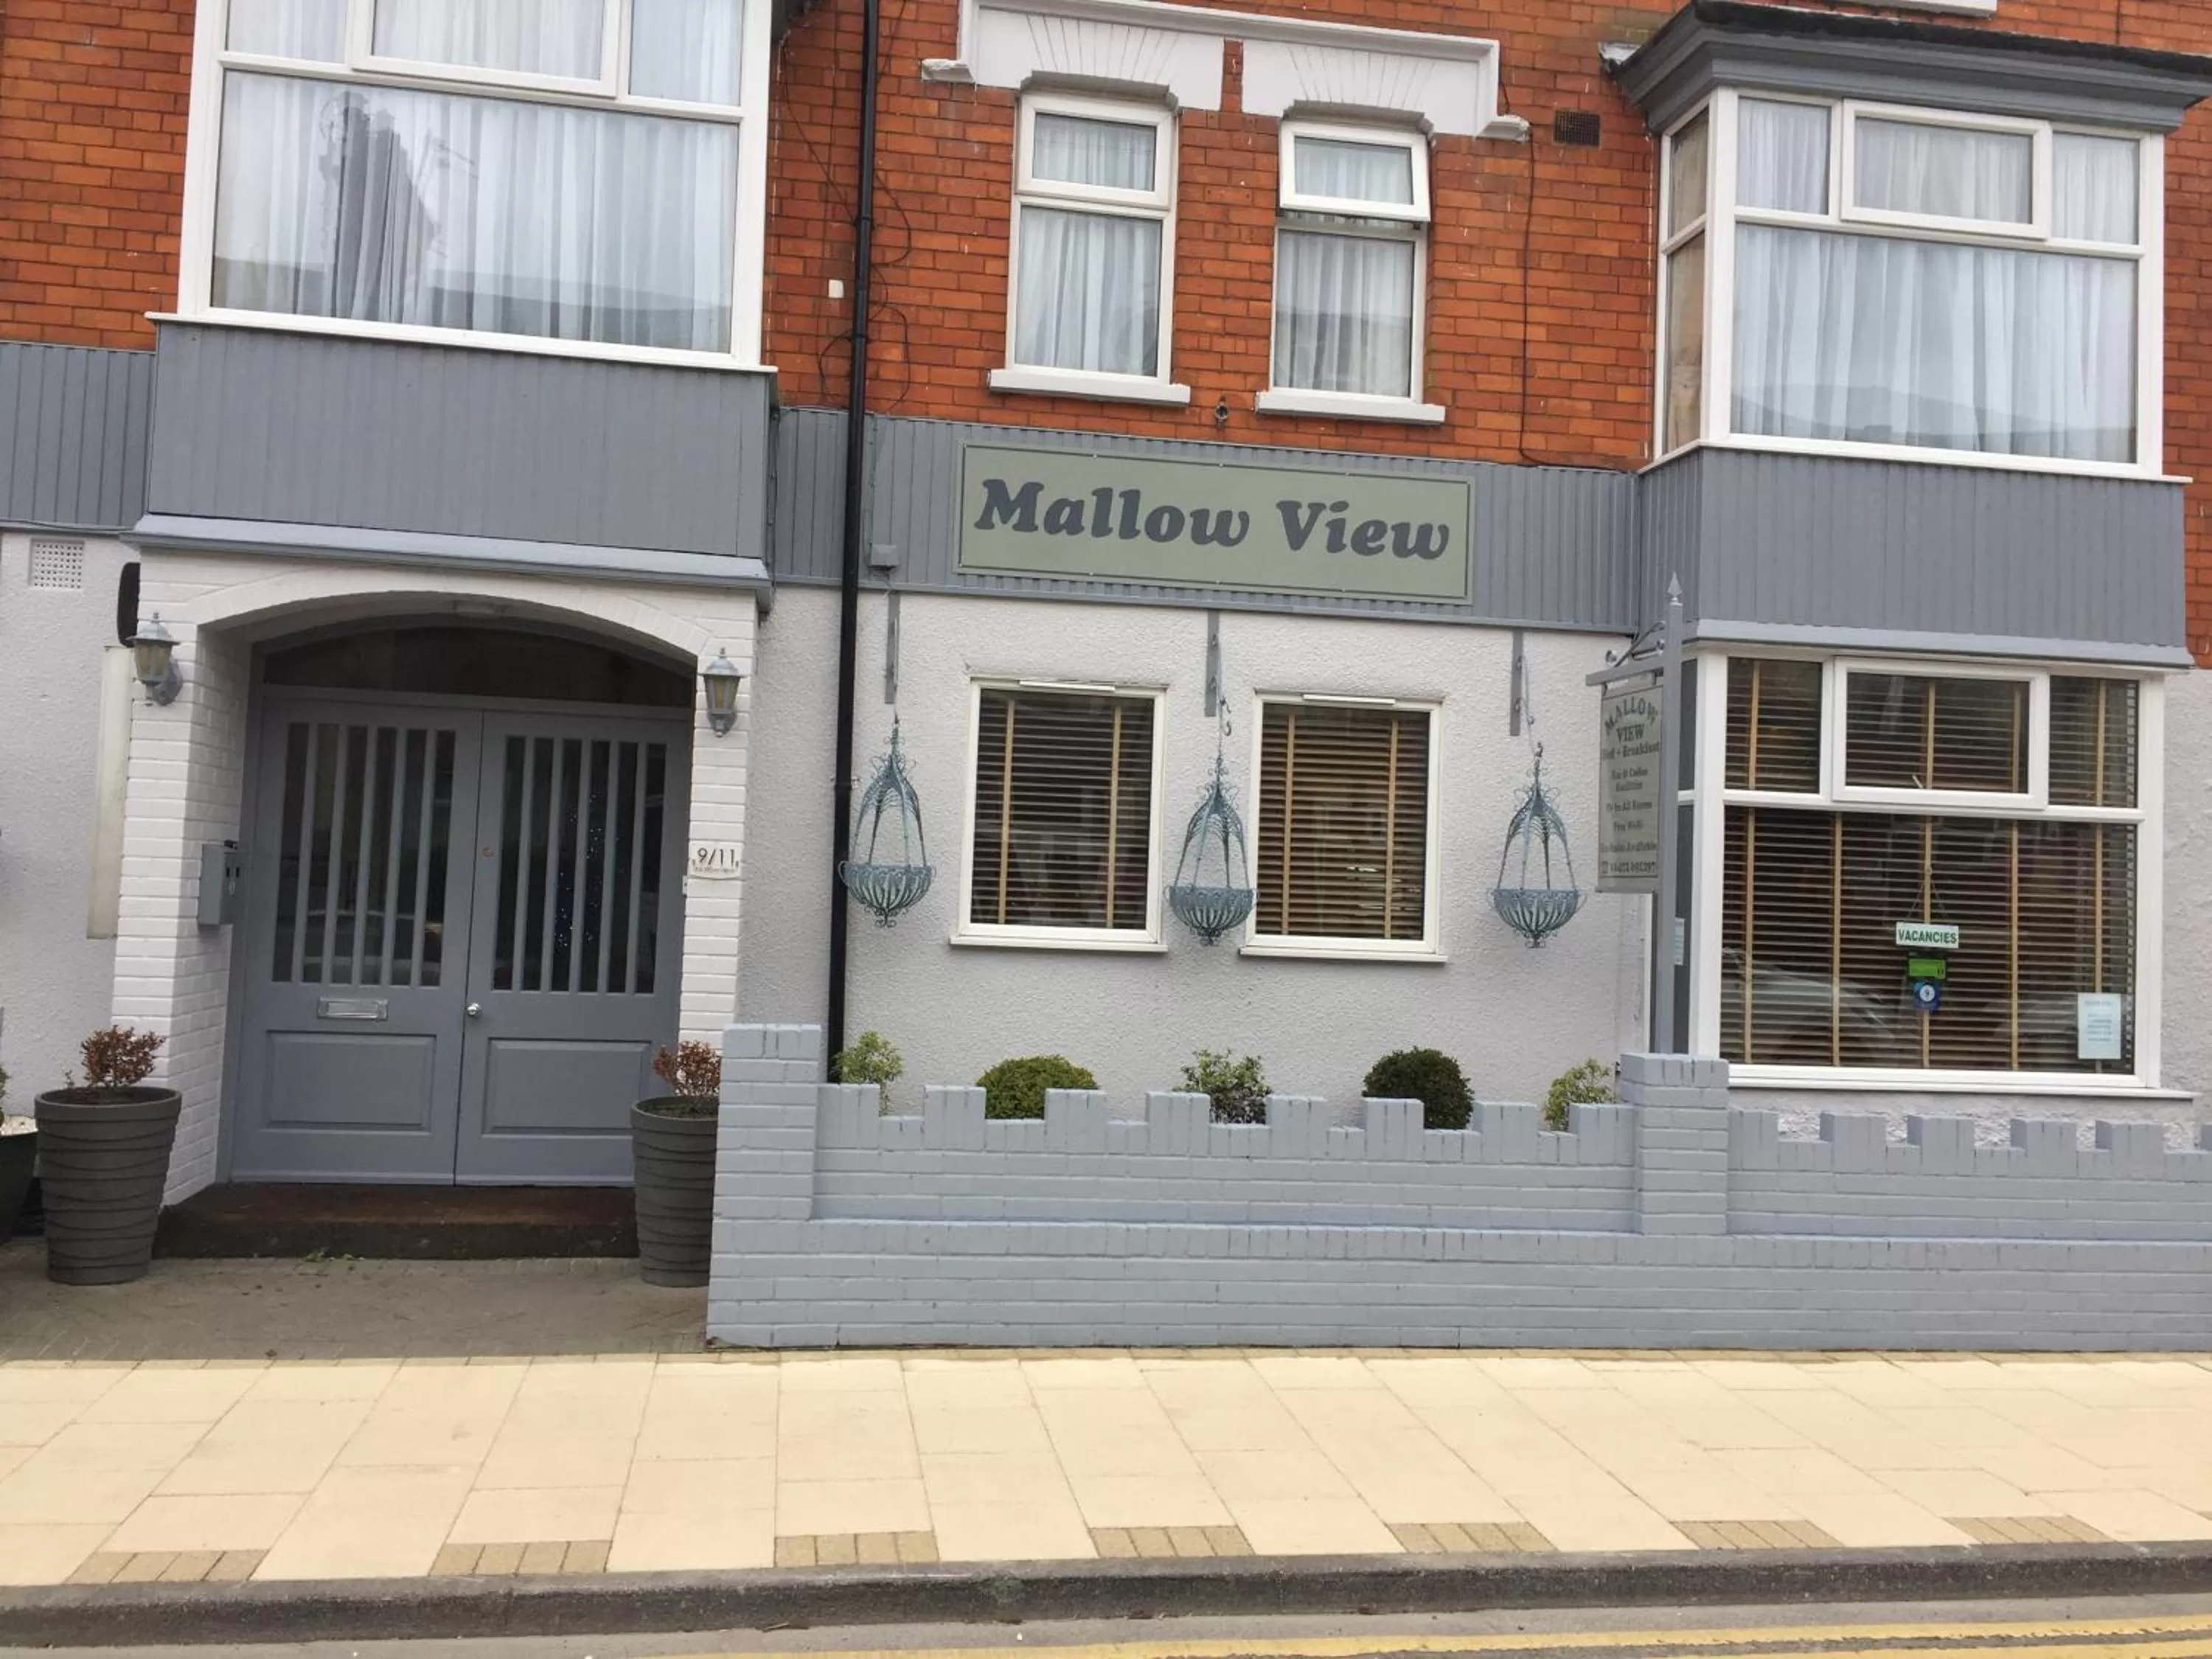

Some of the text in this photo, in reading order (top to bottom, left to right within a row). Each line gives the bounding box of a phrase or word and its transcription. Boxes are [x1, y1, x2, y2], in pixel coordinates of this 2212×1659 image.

[973, 479, 1450, 560] Mallow View
[1604, 696, 1658, 736] MALLOW
[1616, 723, 1645, 743] VIEW
[697, 847, 735, 867] 9/11
[1898, 928, 1958, 945] VACANCIES
